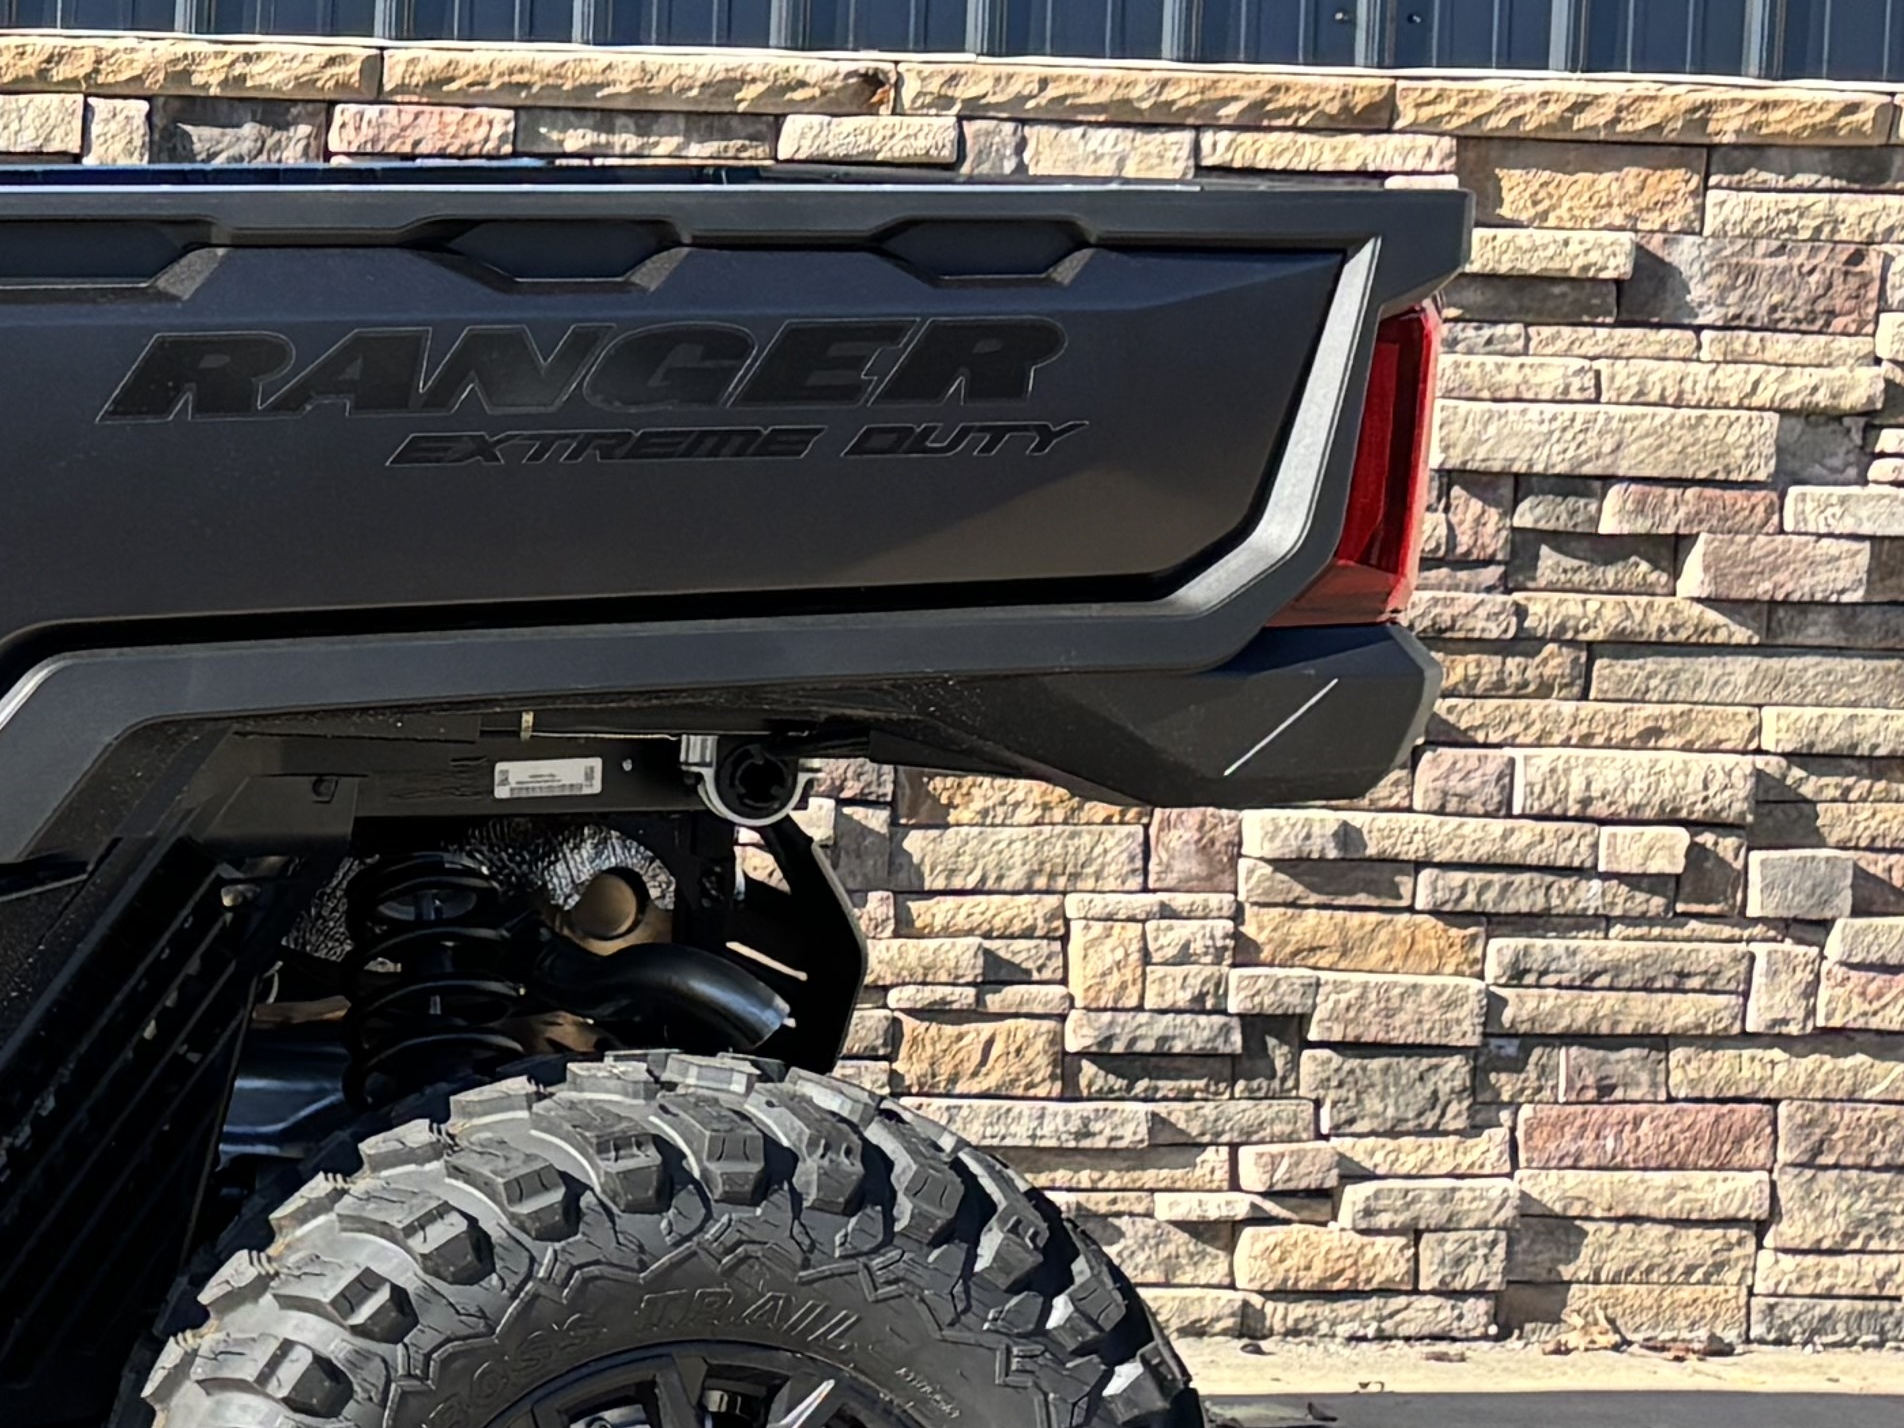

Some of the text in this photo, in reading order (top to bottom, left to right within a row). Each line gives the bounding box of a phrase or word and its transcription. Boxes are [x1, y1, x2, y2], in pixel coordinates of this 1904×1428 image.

[96, 316, 1068, 423] RANGER
[385, 419, 1090, 468] EXTREME DUTY
